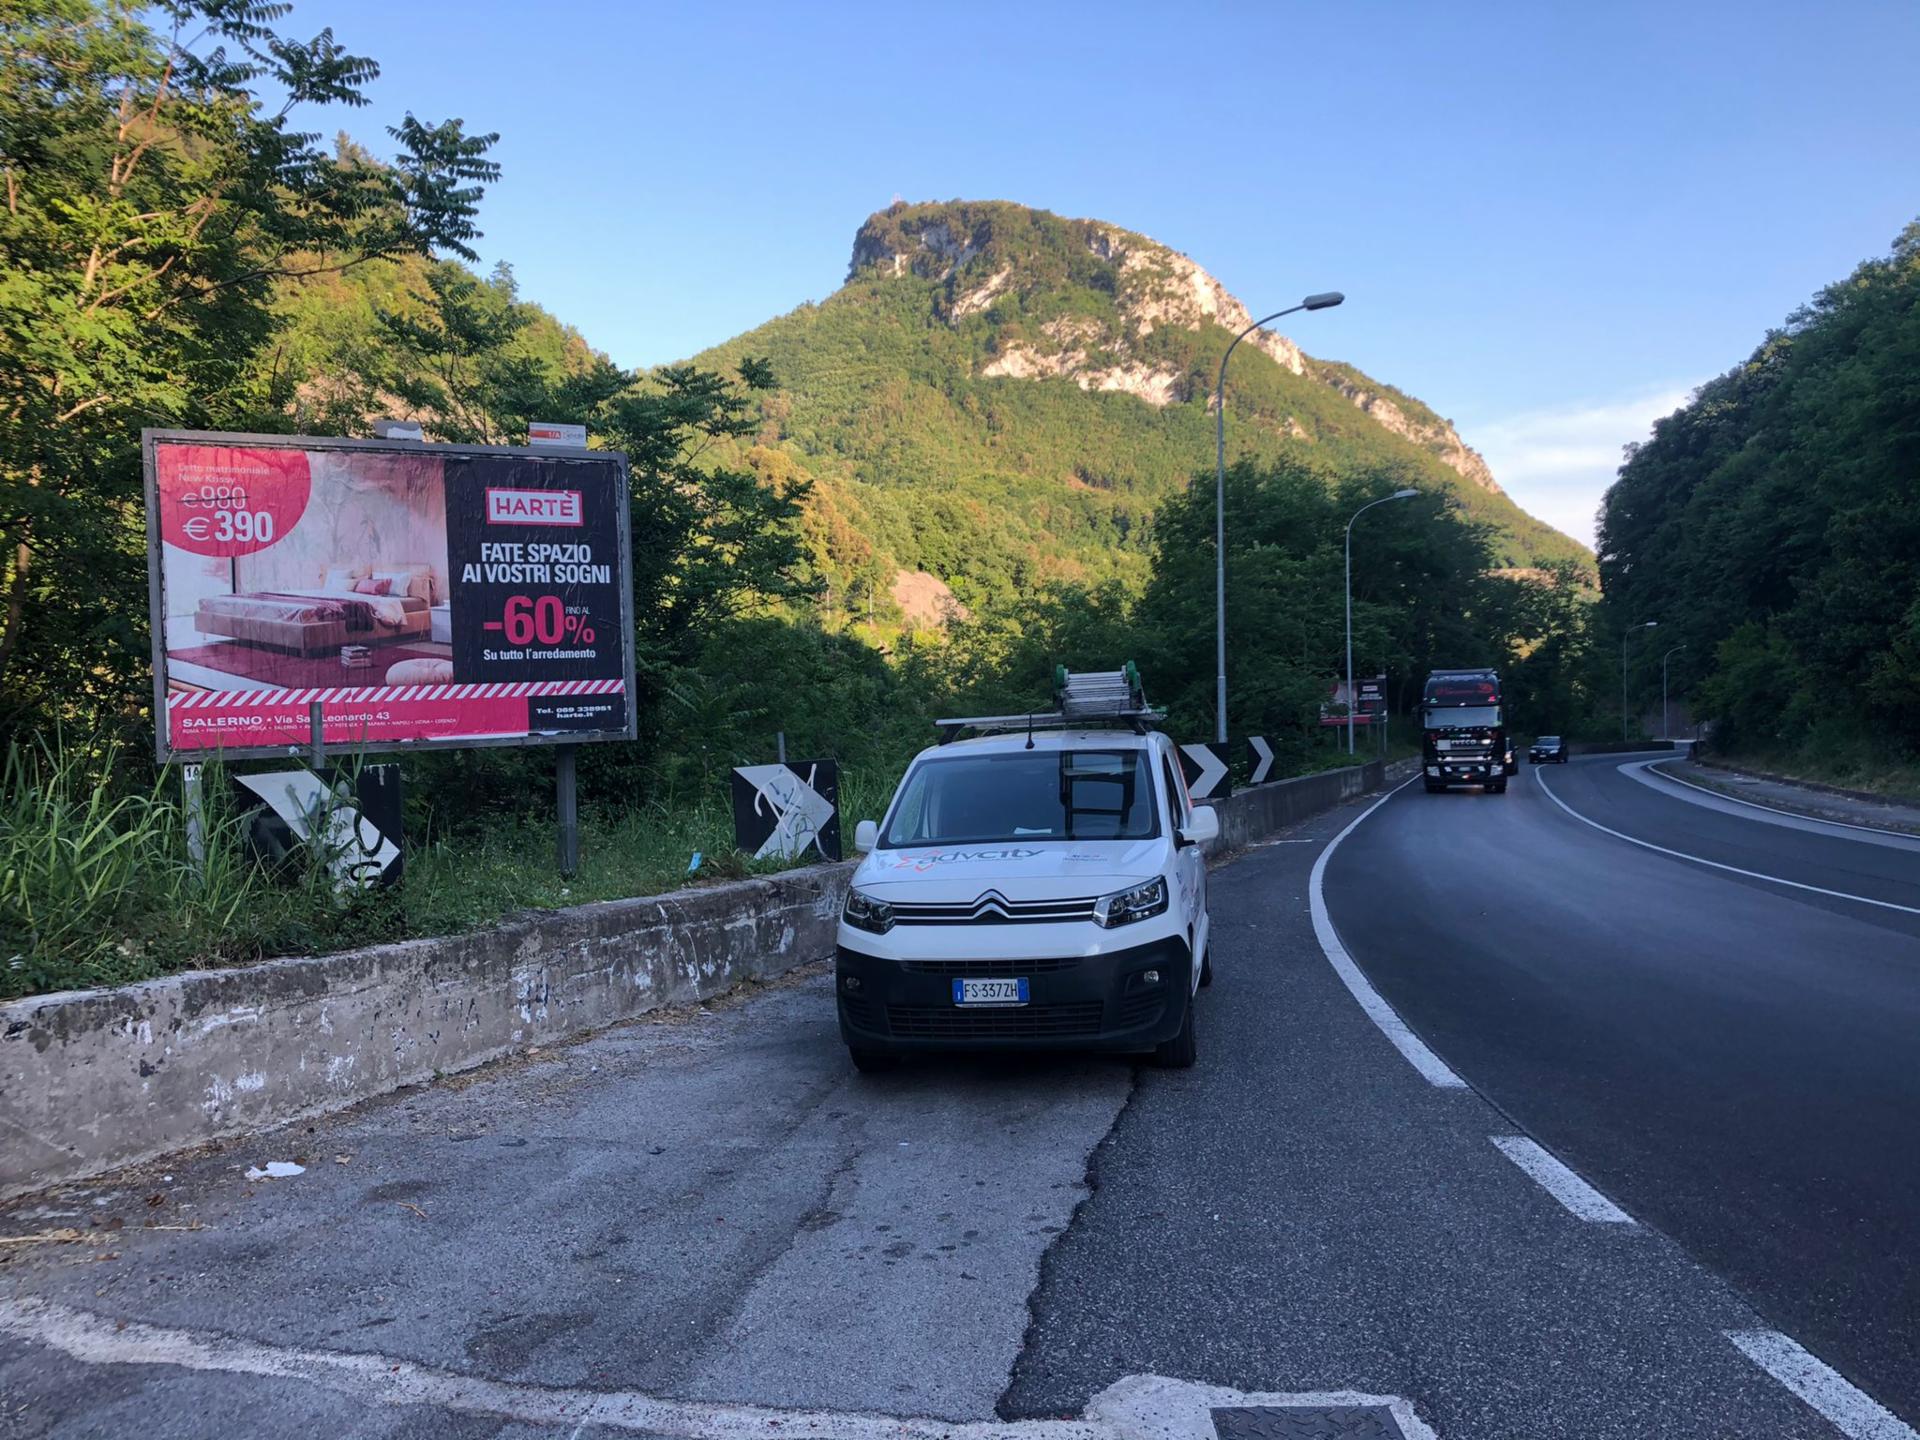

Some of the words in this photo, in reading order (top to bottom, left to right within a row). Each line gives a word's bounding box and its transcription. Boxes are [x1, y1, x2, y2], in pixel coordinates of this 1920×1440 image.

[481, 543, 524, 562] FATE
[527, 543, 591, 563] SPAZIO
[461, 563, 481, 583] AI
[484, 563, 550, 583] VOSTRI
[554, 565, 611, 584] SOGNI
[565, 606, 580, 614] FINO
[581, 606, 590, 614] AL
[483, 649, 497, 660] Su
[500, 649, 523, 660] tutto
[526, 648, 596, 659] l'arredamento
[182, 716, 262, 727] SALERNO
[274, 715, 293, 724] Via
[321, 712, 374, 722] Leonardo
[375, 711, 390, 720] 43
